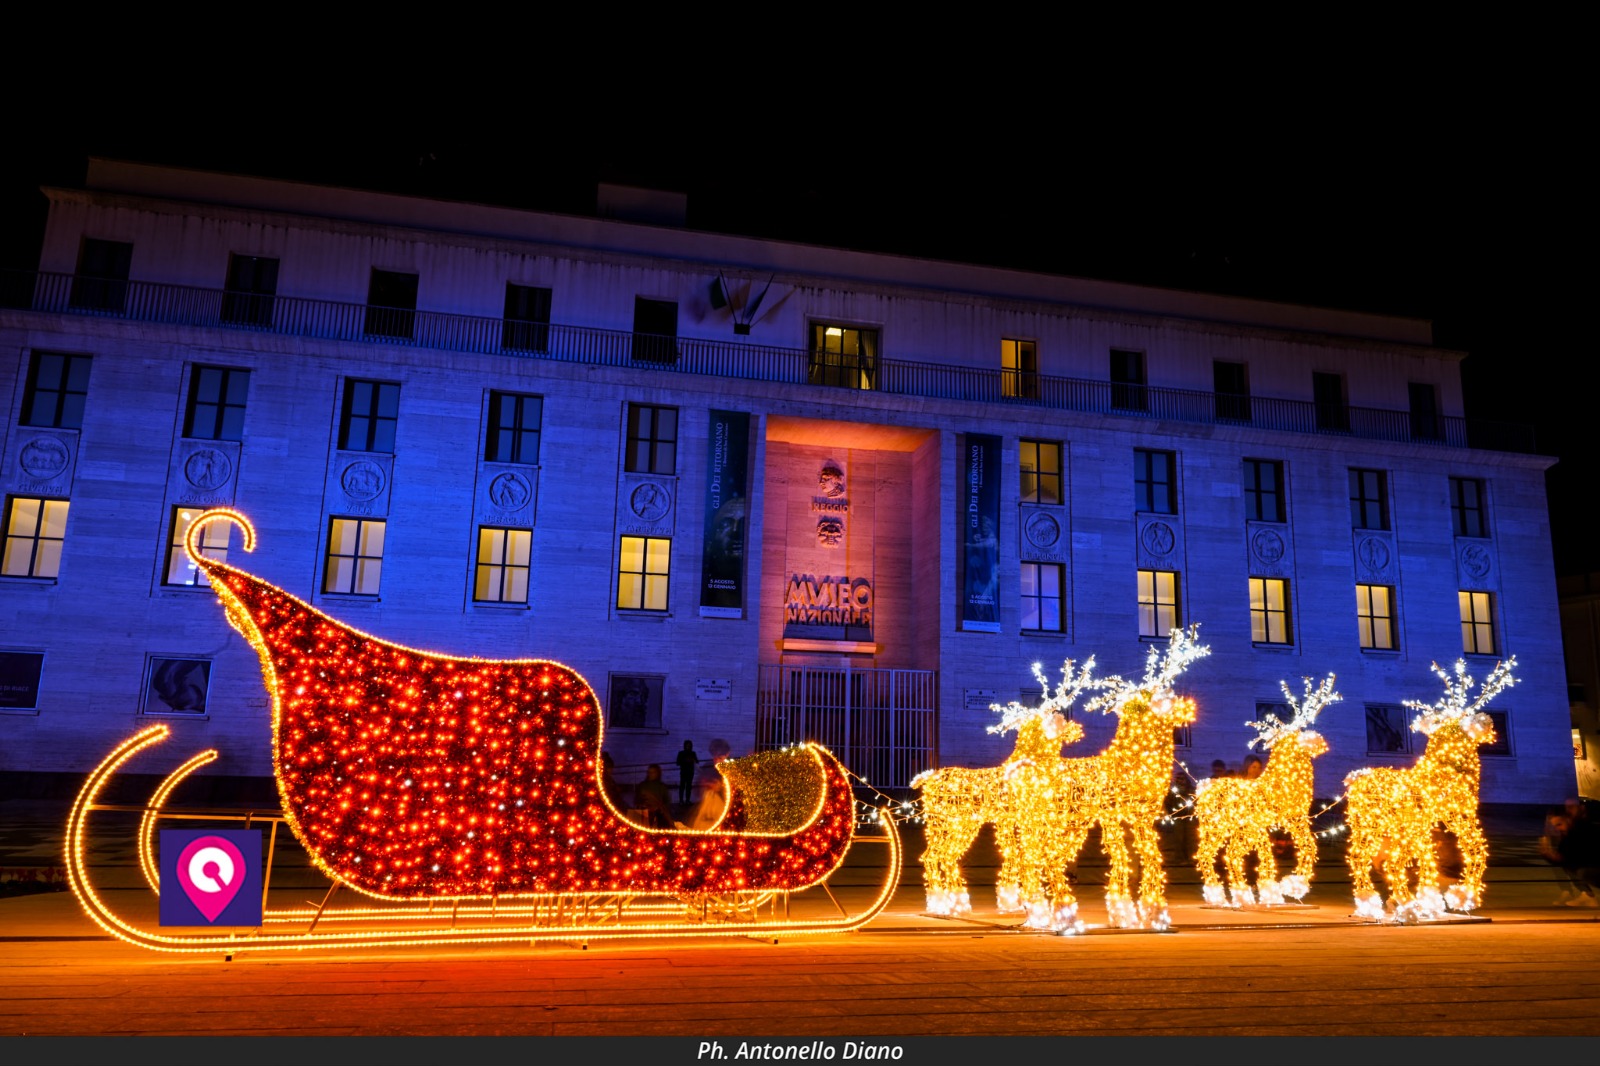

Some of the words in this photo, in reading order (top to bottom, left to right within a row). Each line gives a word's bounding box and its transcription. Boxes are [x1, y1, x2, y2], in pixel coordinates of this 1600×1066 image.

[714, 422, 724, 473] RITORNANO
[971, 445, 979, 494] RITORNANO
[712, 495, 721, 509] GLI
[812, 502, 849, 513] REGGIO
[971, 514, 979, 528] GLI
